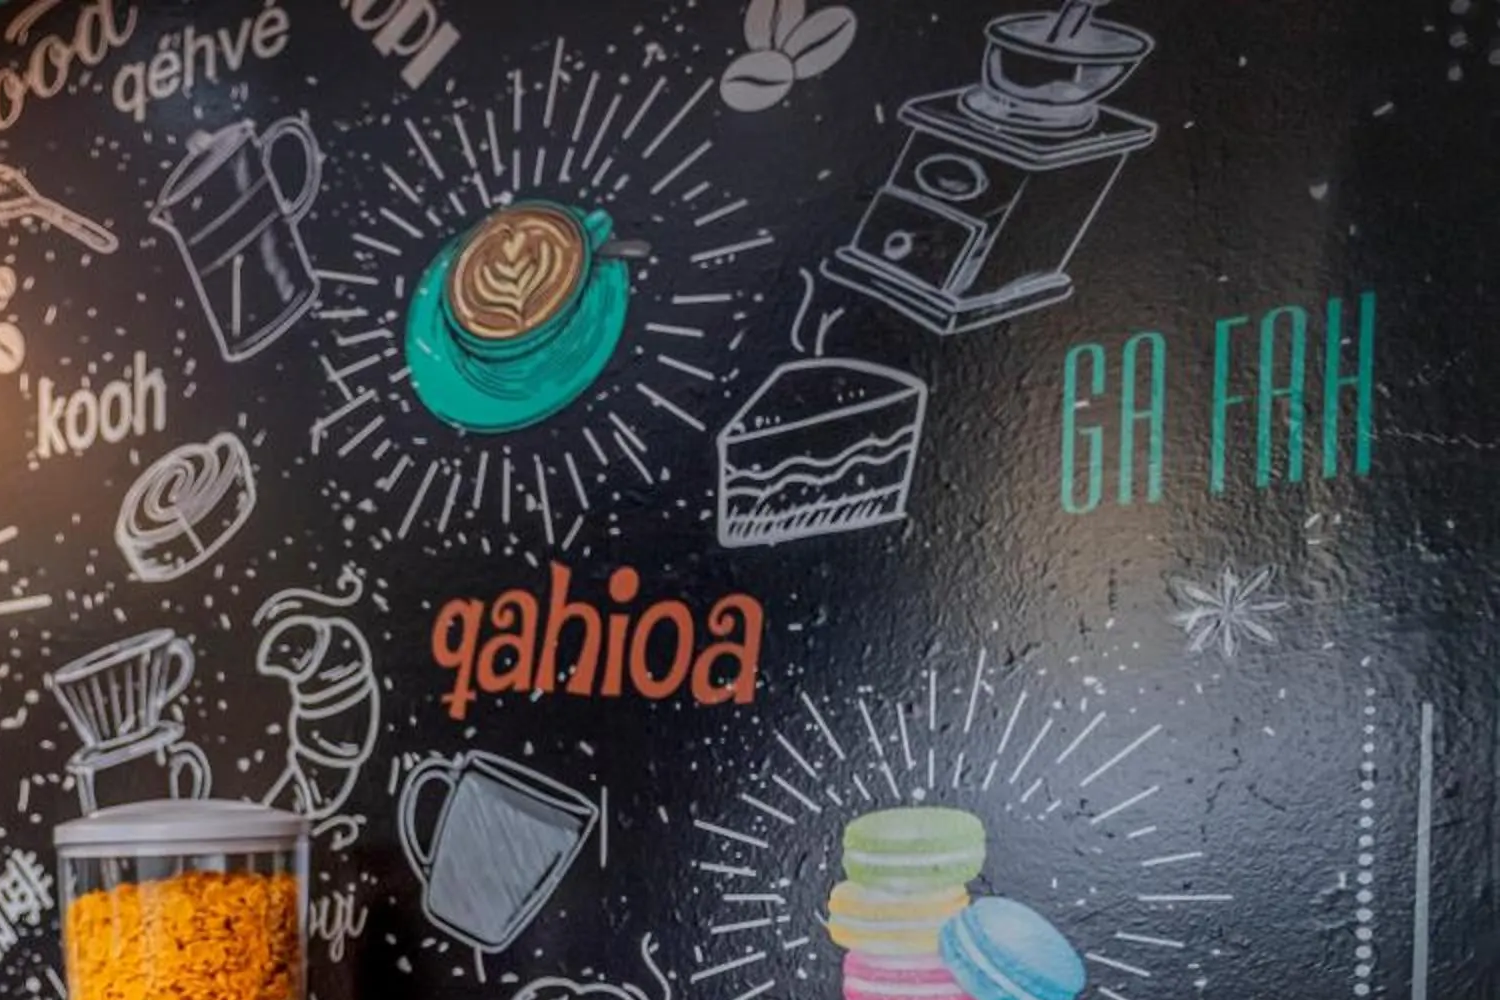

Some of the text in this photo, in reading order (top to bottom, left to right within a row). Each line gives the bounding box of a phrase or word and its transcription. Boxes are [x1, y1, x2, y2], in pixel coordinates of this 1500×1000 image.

[1060, 291, 1377, 515] GA FAH
[431, 560, 764, 720] qahioa
